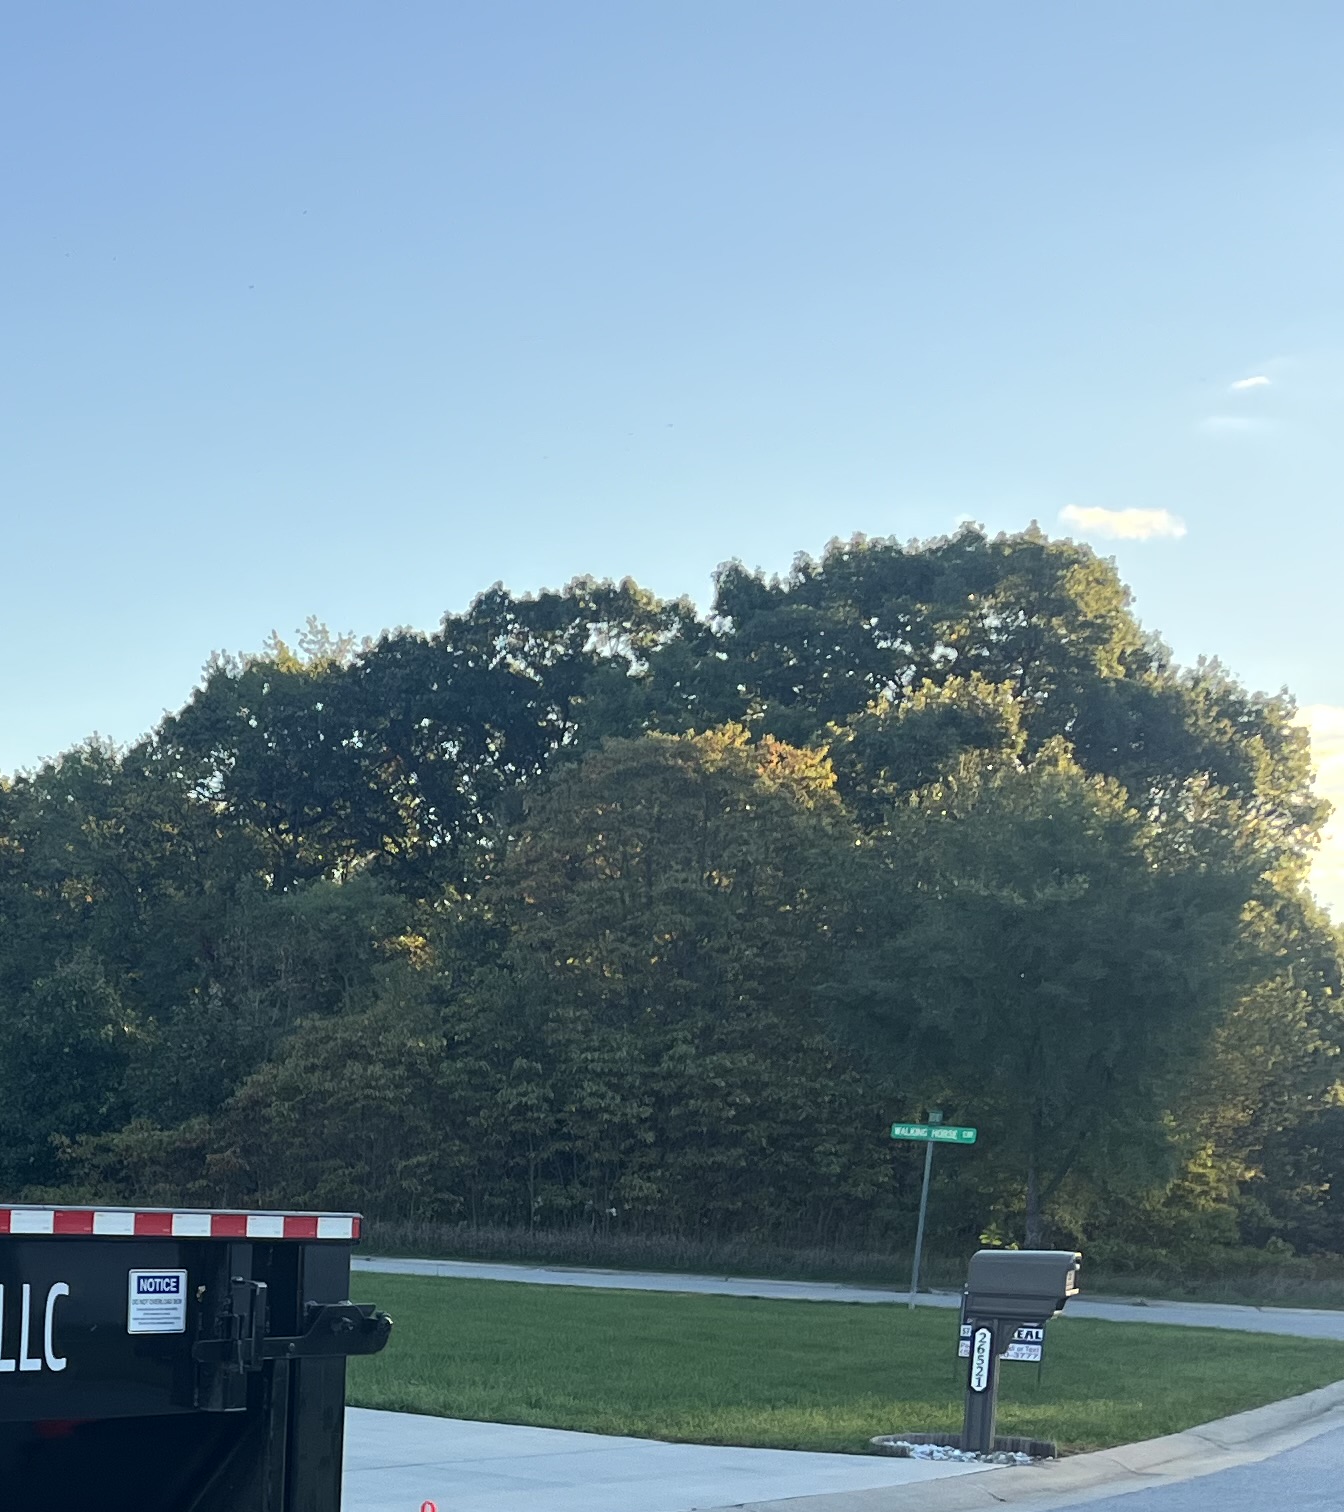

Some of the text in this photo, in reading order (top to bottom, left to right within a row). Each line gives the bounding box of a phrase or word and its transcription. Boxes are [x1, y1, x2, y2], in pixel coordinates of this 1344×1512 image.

[894, 1126, 927, 1137] WALKING
[931, 1129, 957, 1140] HORSE
[139, 1278, 177, 1292] NOTICE
[1016, 1330, 1041, 1340] EAL
[975, 1332, 987, 1388] 26521
